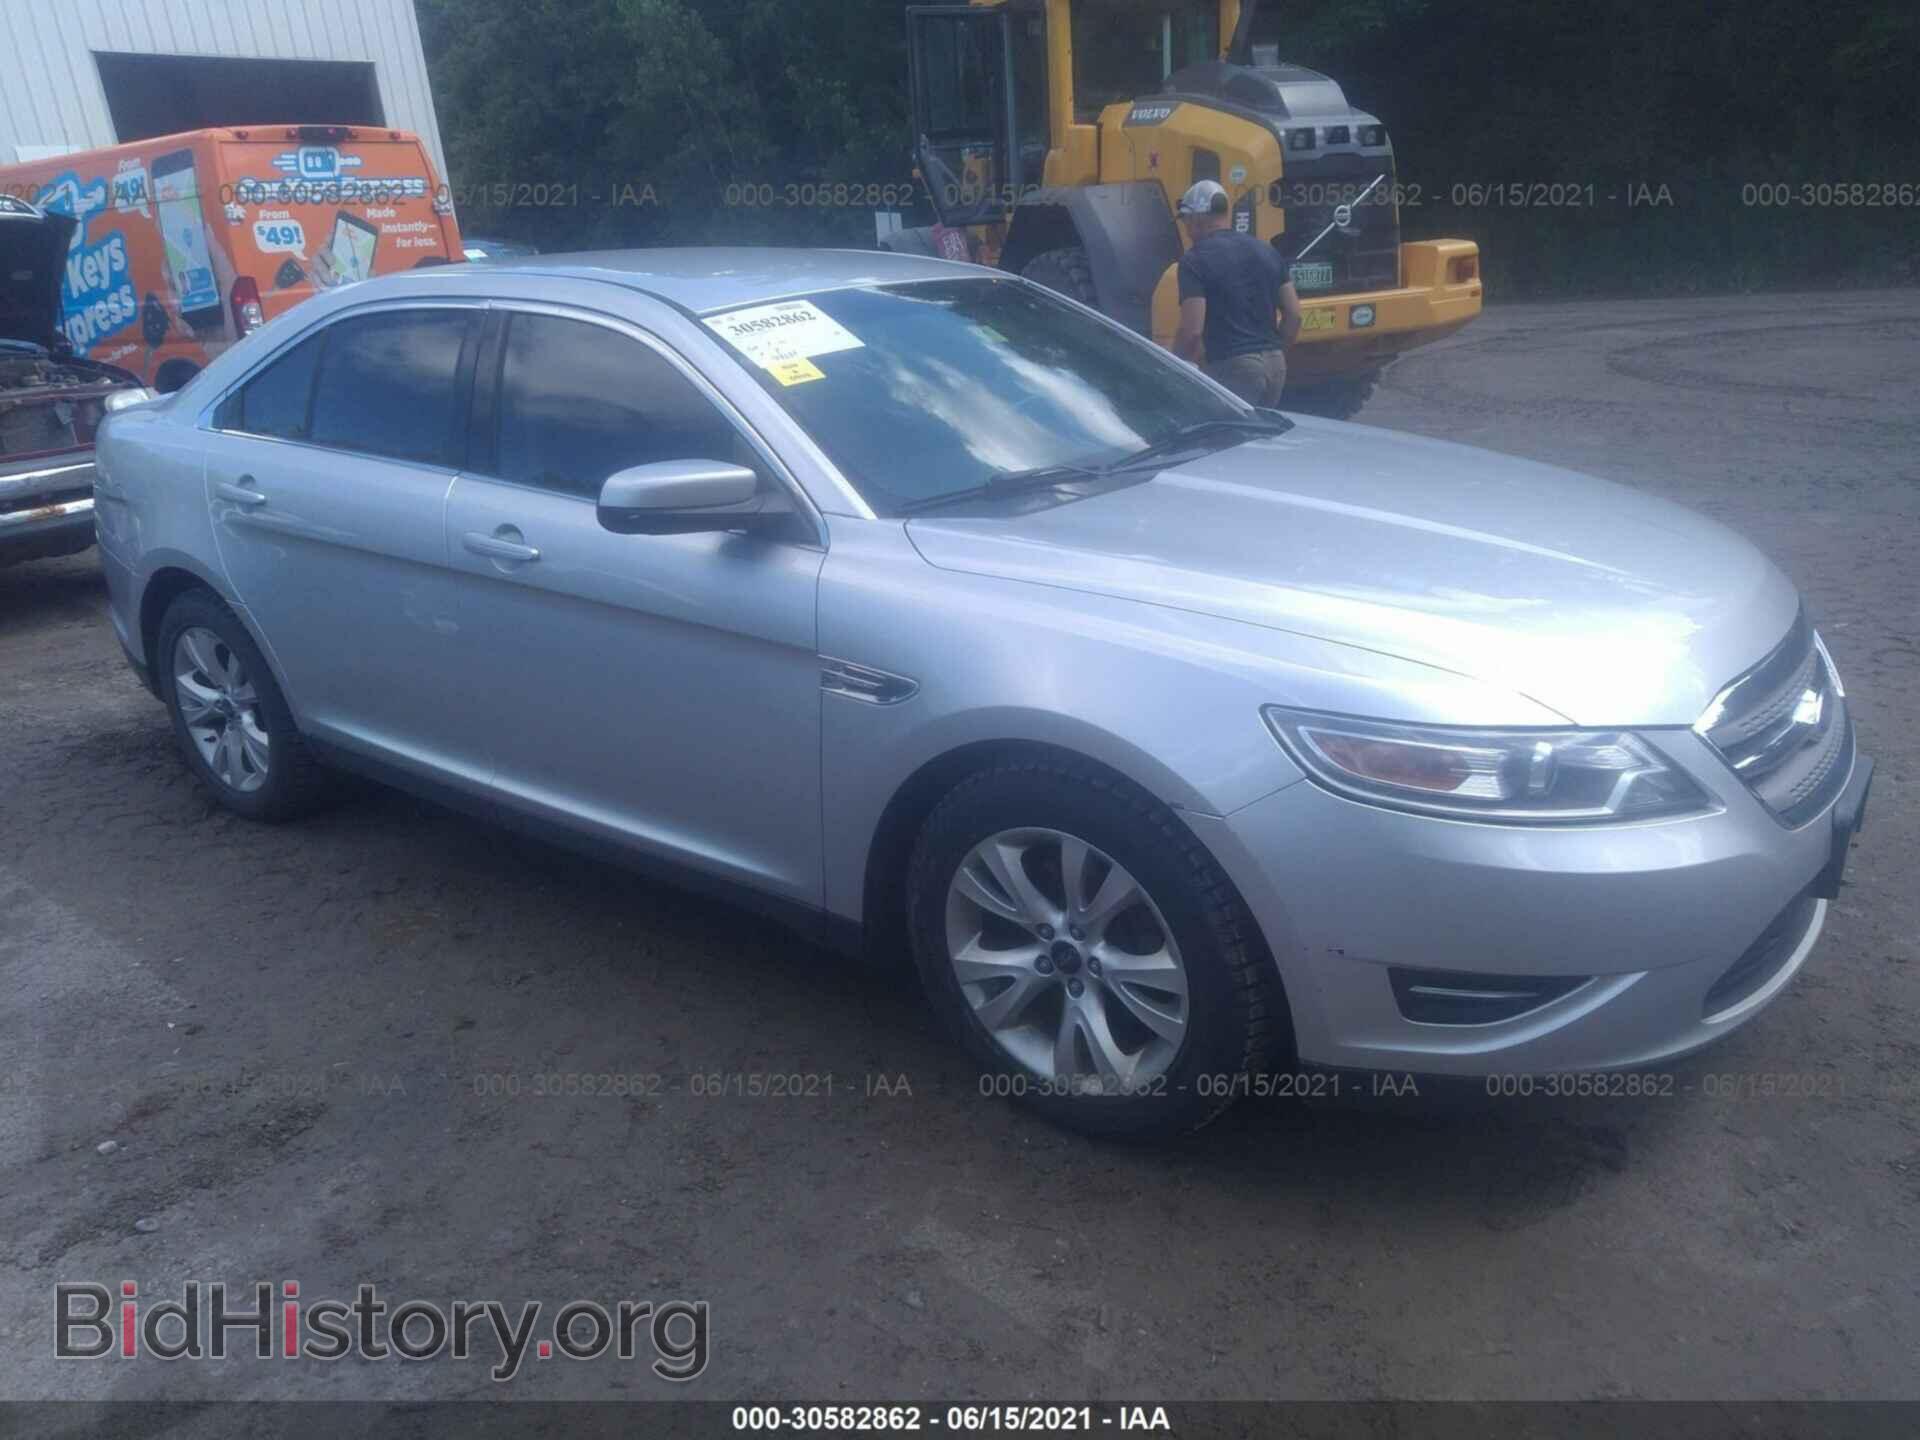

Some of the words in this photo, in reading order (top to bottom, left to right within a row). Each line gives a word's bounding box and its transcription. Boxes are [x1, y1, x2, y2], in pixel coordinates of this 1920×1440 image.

[1131, 107, 1171, 120] VOLVO
[258, 209, 290, 220] From
[366, 207, 397, 219] Made
[256, 224, 303, 246] $49!
[66, 237, 126, 299] Keys
[727, 310, 817, 337] 30582862
